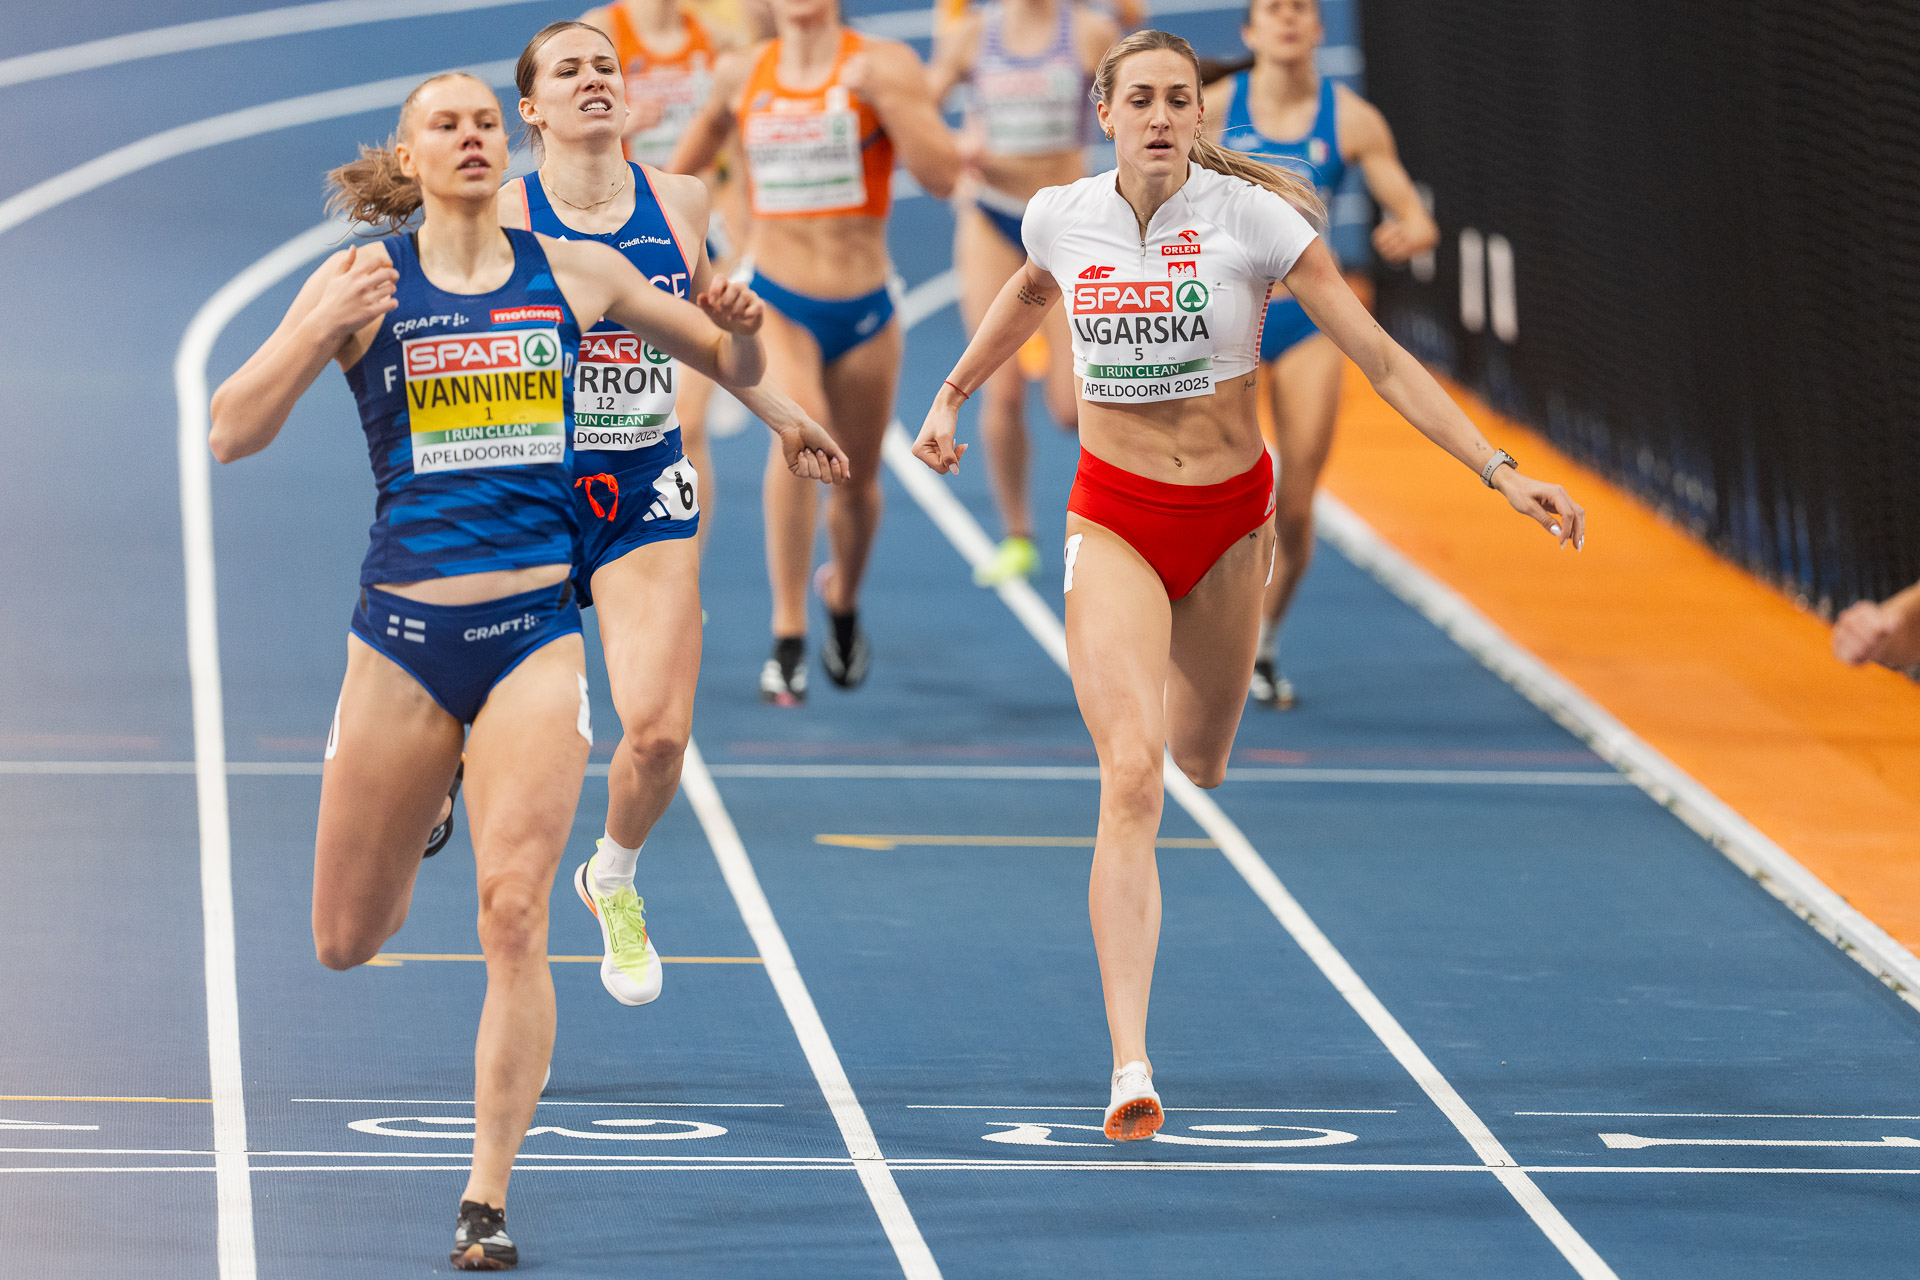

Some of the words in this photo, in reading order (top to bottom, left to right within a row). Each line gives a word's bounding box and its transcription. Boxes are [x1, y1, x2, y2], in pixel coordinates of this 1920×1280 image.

[619, 238, 640, 249] Crédit
[648, 235, 671, 245] Mutuel
[1163, 246, 1198, 254] ORLEN
[1078, 265, 1115, 279] 4F
[1076, 285, 1170, 310] SPAR
[393, 315, 452, 336] CRAFT
[494, 309, 562, 321] motonet
[1074, 315, 1209, 345] LIGARSKA
[409, 339, 519, 372] SPAR
[579, 338, 638, 359] PAR
[1135, 348, 1144, 361] 5
[574, 366, 672, 394] RRON
[1100, 366, 1104, 376] I
[1106, 366, 1133, 377] RUN
[409, 371, 556, 410] VANNINEN
[1085, 382, 1171, 397] APELDOORN
[1174, 376, 1209, 393] 2025
[485, 407, 493, 420] 1
[596, 397, 615, 410] 12
[445, 431, 449, 442] I
[452, 427, 484, 441] RUN
[574, 432, 633, 444] DOORN
[421, 445, 524, 466] APELDOORN
[528, 443, 562, 456] 2025
[463, 618, 523, 642] CRAFT
[347, 1116, 728, 1140] 3
